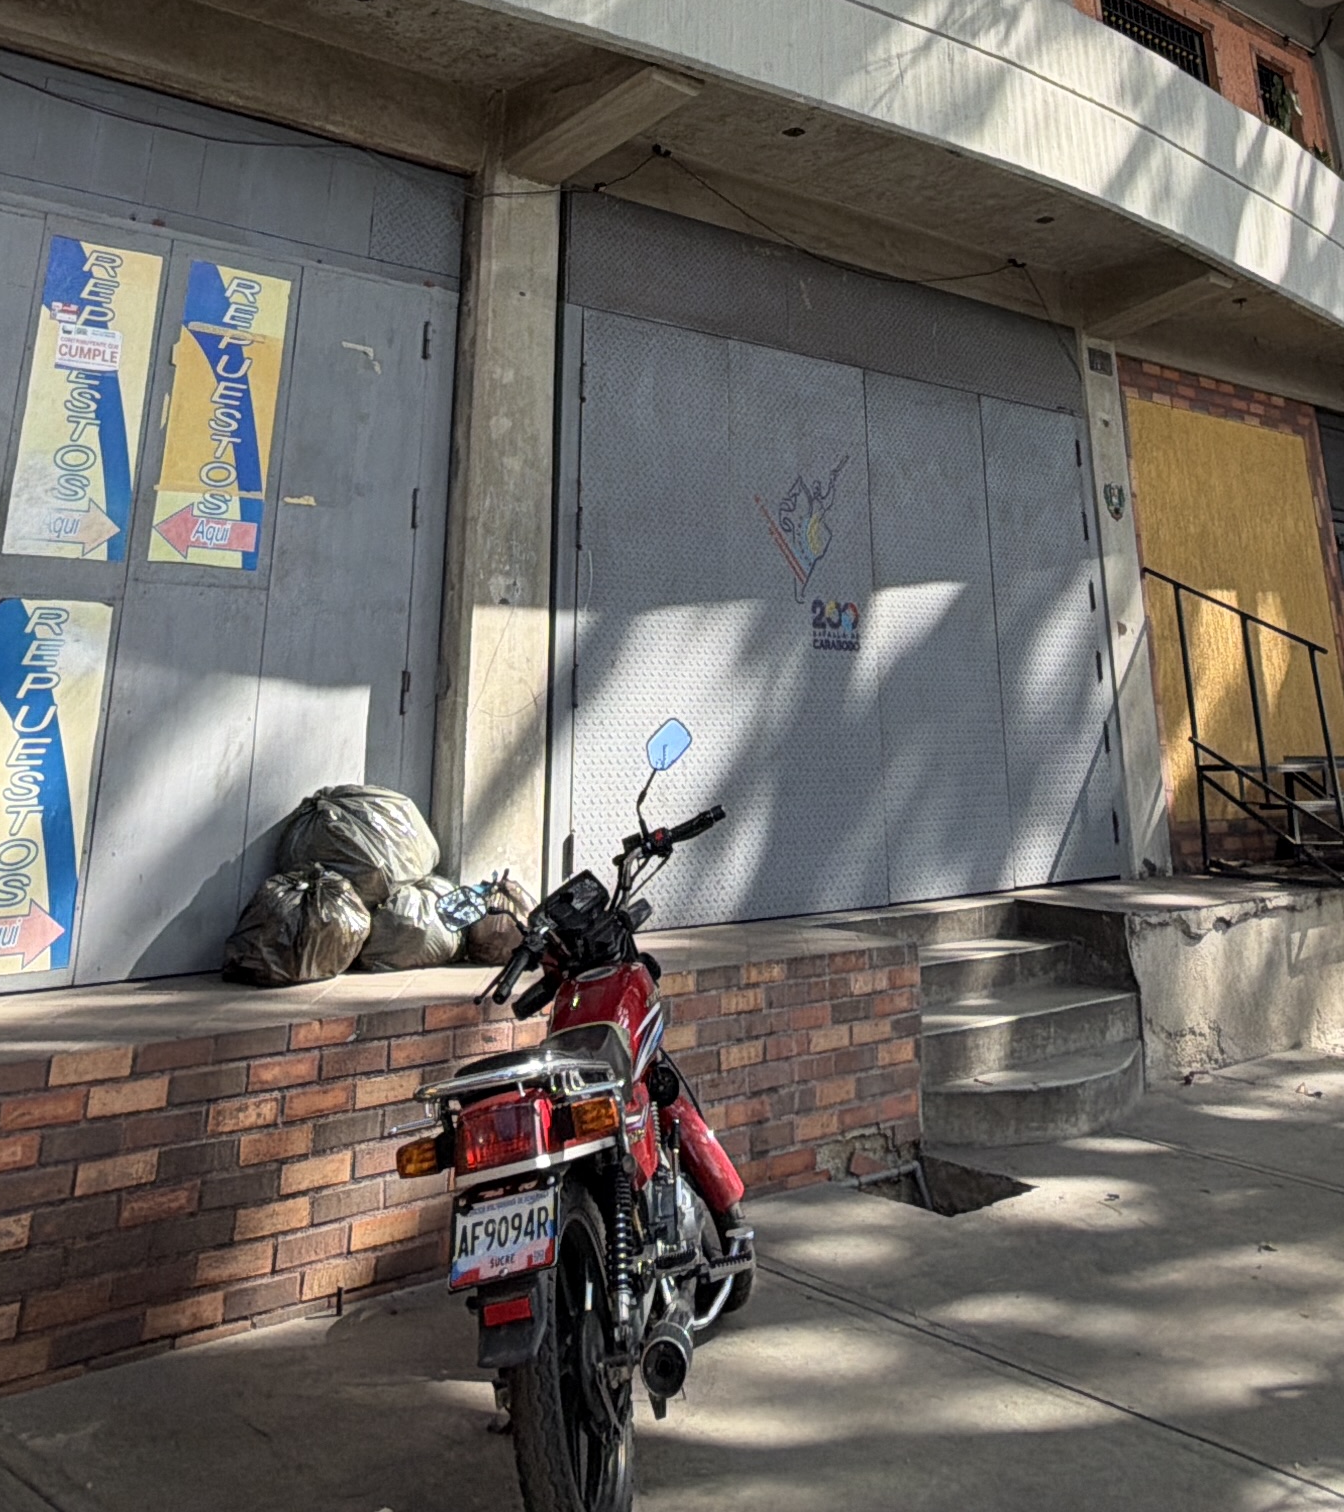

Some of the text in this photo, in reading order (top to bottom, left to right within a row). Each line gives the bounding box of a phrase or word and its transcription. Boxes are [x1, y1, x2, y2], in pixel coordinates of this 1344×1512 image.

[58, 343, 119, 364] CUMPLE
[192, 519, 231, 546] Aqui
[458, 1205, 549, 1259] AF9094R
[489, 1253, 516, 1269] SUCRE
